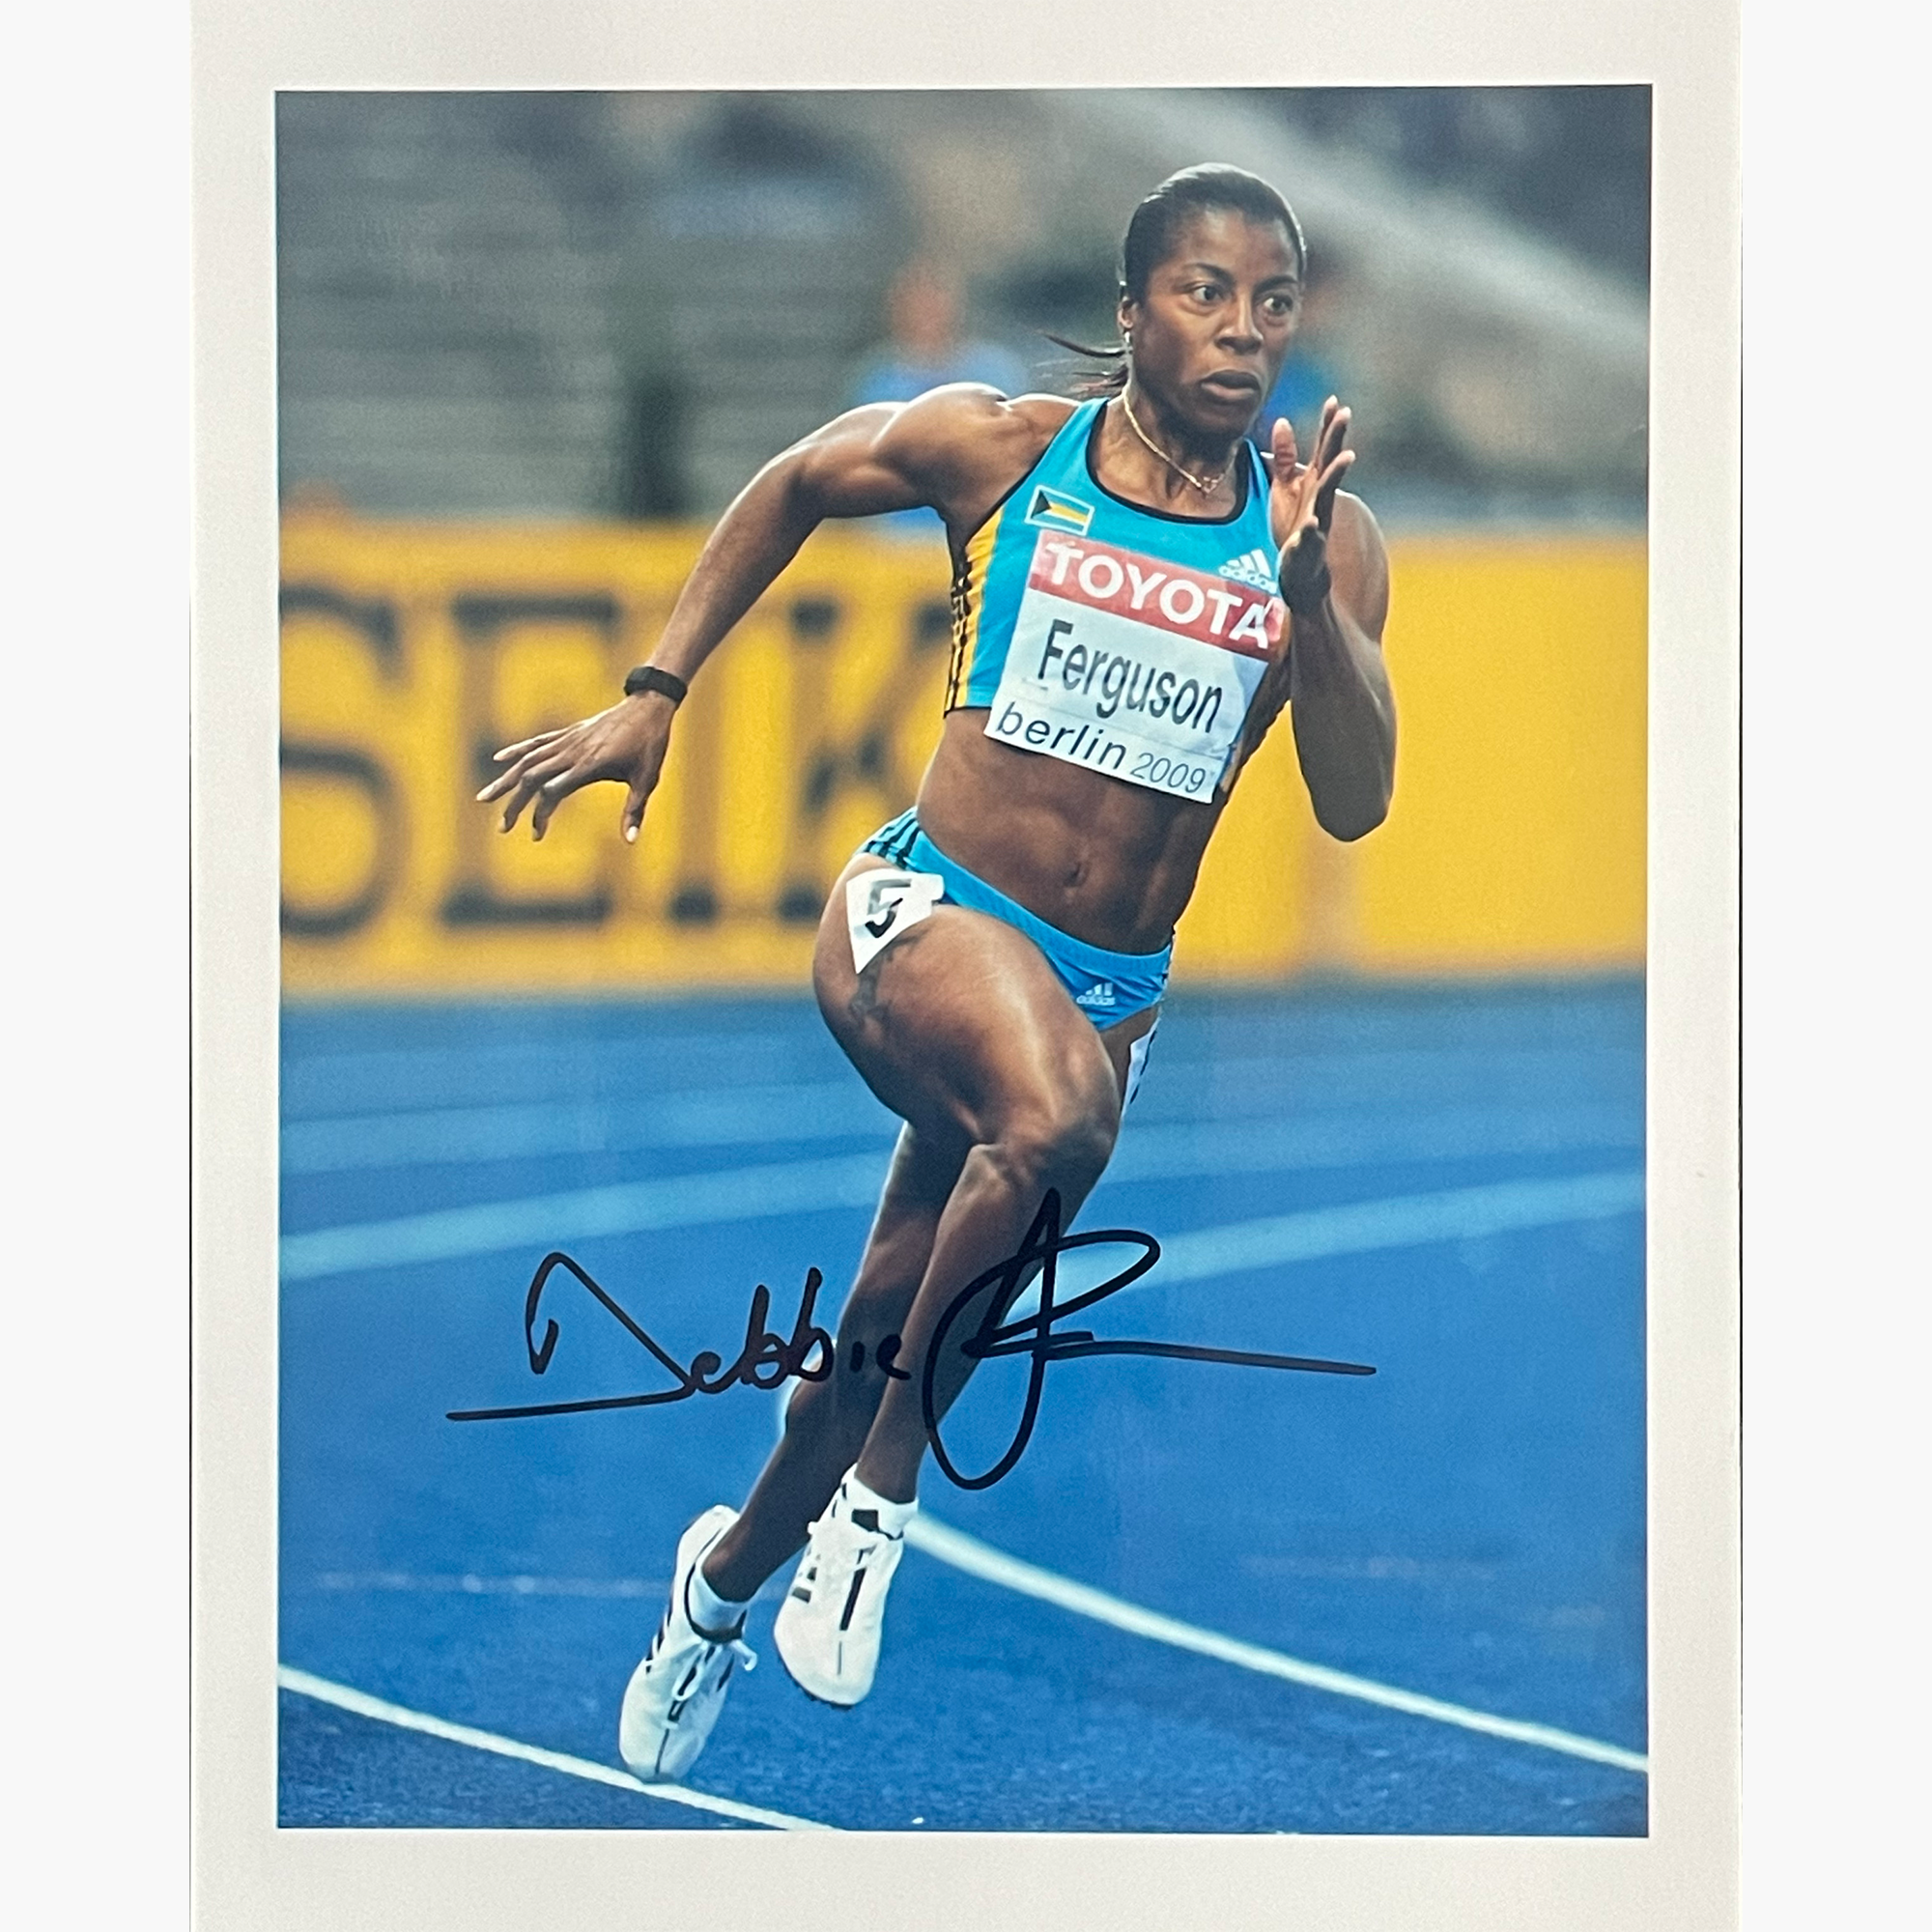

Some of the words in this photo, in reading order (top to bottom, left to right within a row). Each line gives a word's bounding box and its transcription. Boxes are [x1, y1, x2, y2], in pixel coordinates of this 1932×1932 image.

[1047, 541, 1274, 649] TOYOTA
[1037, 618, 1223, 734] Ferguson
[997, 702, 1127, 771] berlin
[1130, 753, 1207, 794] 2009
[865, 878, 911, 937] 5
